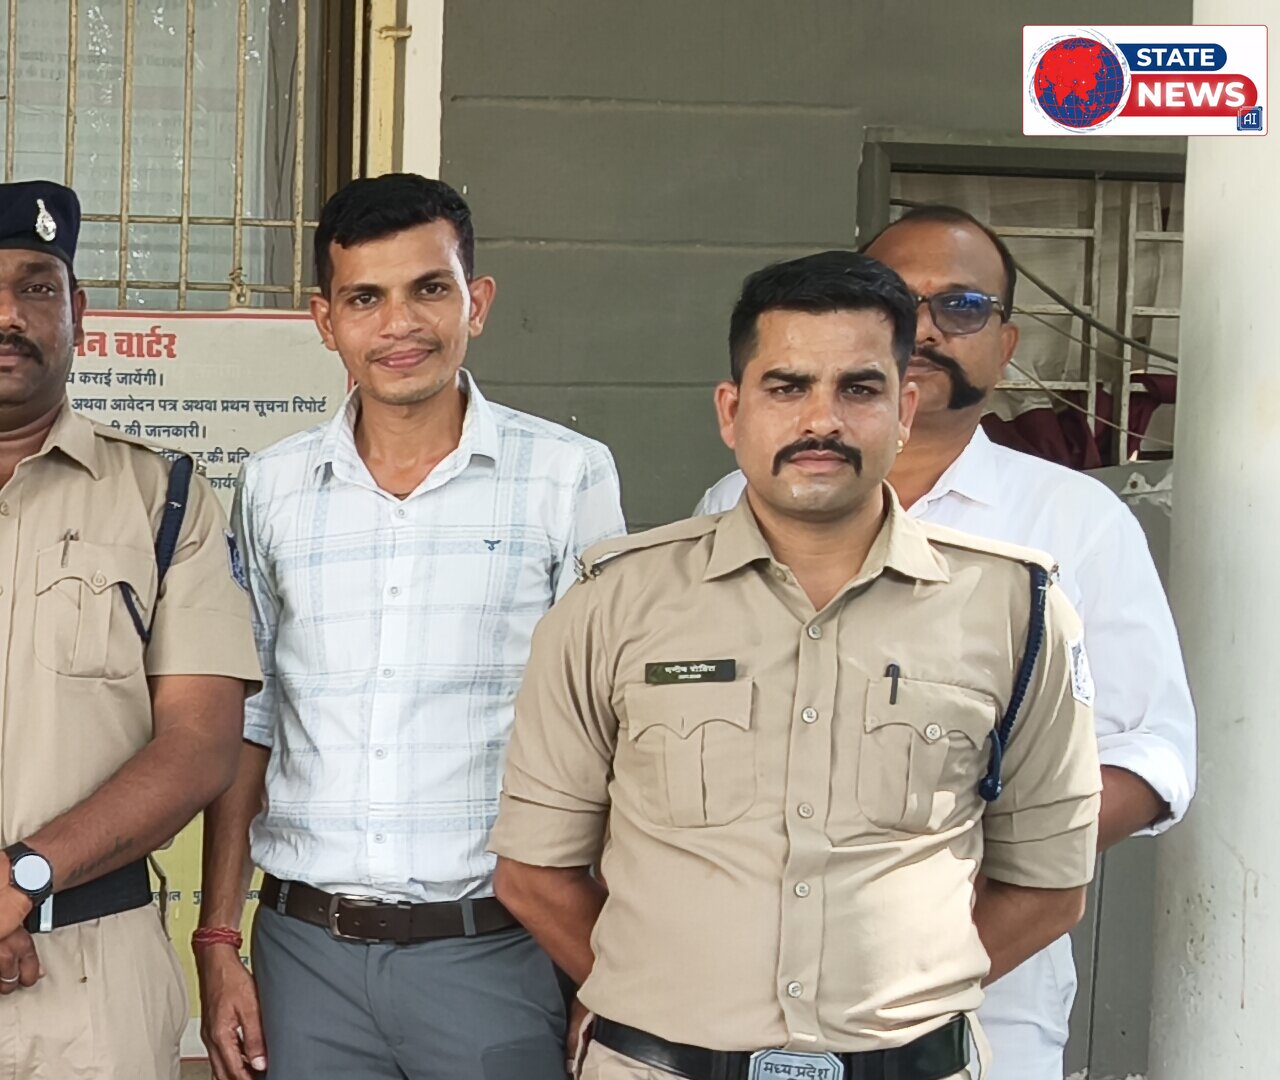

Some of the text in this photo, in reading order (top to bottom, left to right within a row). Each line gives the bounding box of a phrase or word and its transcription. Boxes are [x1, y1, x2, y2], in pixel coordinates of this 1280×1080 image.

[113, 325, 178, 359] चार्टर
[79, 368, 112, 387] कराई
[72, 397, 107, 411] अथवा
[110, 395, 155, 413] आवेदन
[158, 397, 177, 412] पत्र
[181, 397, 217, 413] अथवा
[220, 398, 250, 413] प्रथम
[254, 398, 288, 417] सूचना
[292, 396, 327, 414] रिपोर्ट
[763, 1061, 831, 1080] मध्य प्रदेश
